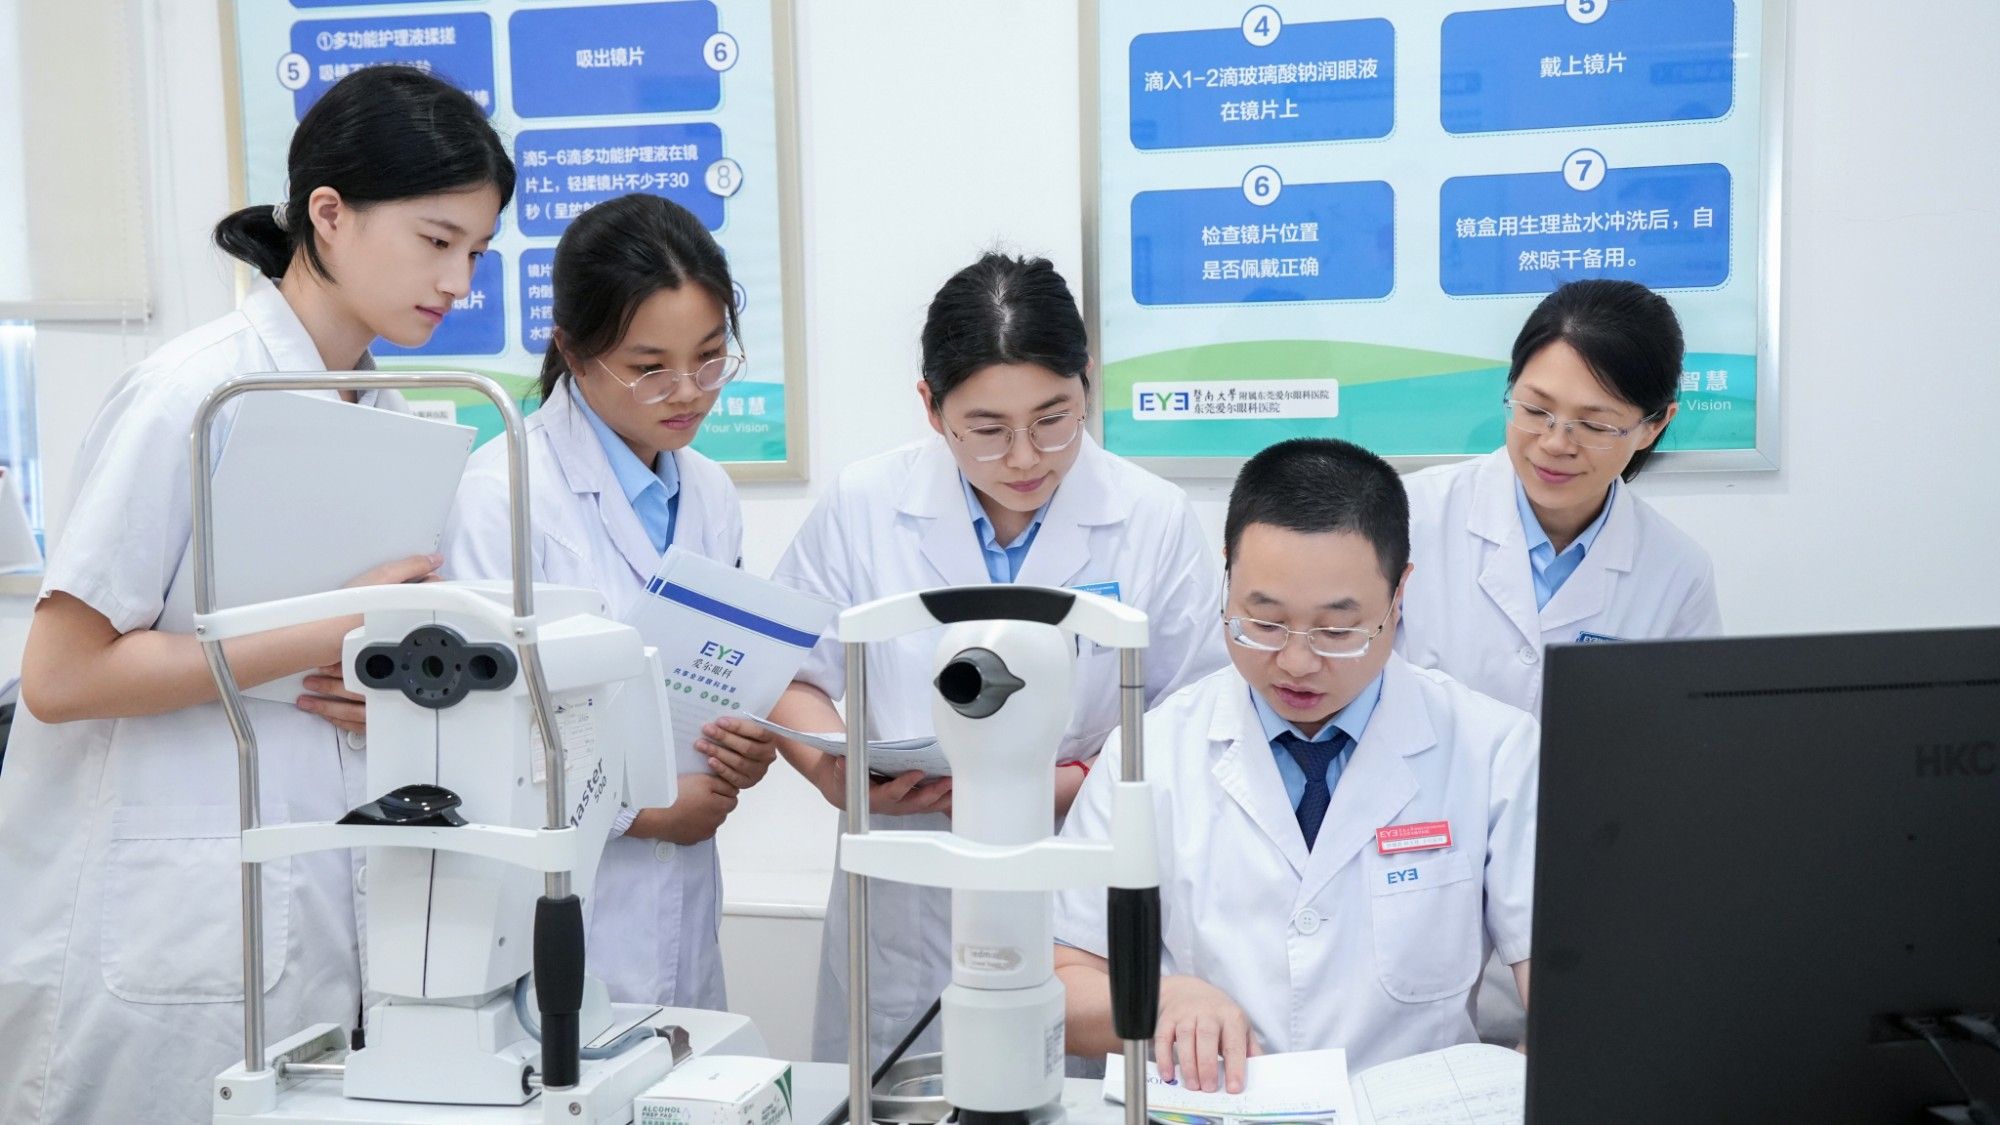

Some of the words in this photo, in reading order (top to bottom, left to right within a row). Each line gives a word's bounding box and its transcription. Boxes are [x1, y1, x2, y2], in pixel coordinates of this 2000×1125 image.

[1578, 0, 1596, 15] 5
[1253, 15, 1271, 37] 4
[575, 45, 645, 69] 吸出镜片
[713, 41, 728, 63] 6
[286, 61, 300, 81] 5
[1539, 51, 1627, 78] 戴上镜片
[1220, 97, 1299, 122] 在镜片上
[716, 164, 732, 190] 8
[1575, 159, 1593, 182] 7
[1254, 175, 1270, 197] 6
[1455, 206, 1713, 239] 镜盒用生理盐水冲洗后，自
[1201, 222, 1319, 247] 检查镜片位置
[1201, 256, 1319, 280] 是否佩戴正确
[1518, 247, 1637, 272] 然晾干备用。
[1679, 369, 1728, 392] 智慧
[1686, 399, 1732, 411] Vision
[704, 422, 730, 433] Your
[733, 421, 769, 433] Vision
[1915, 740, 1998, 778] HKC
[641, 1105, 681, 1114] ALCOHOL
